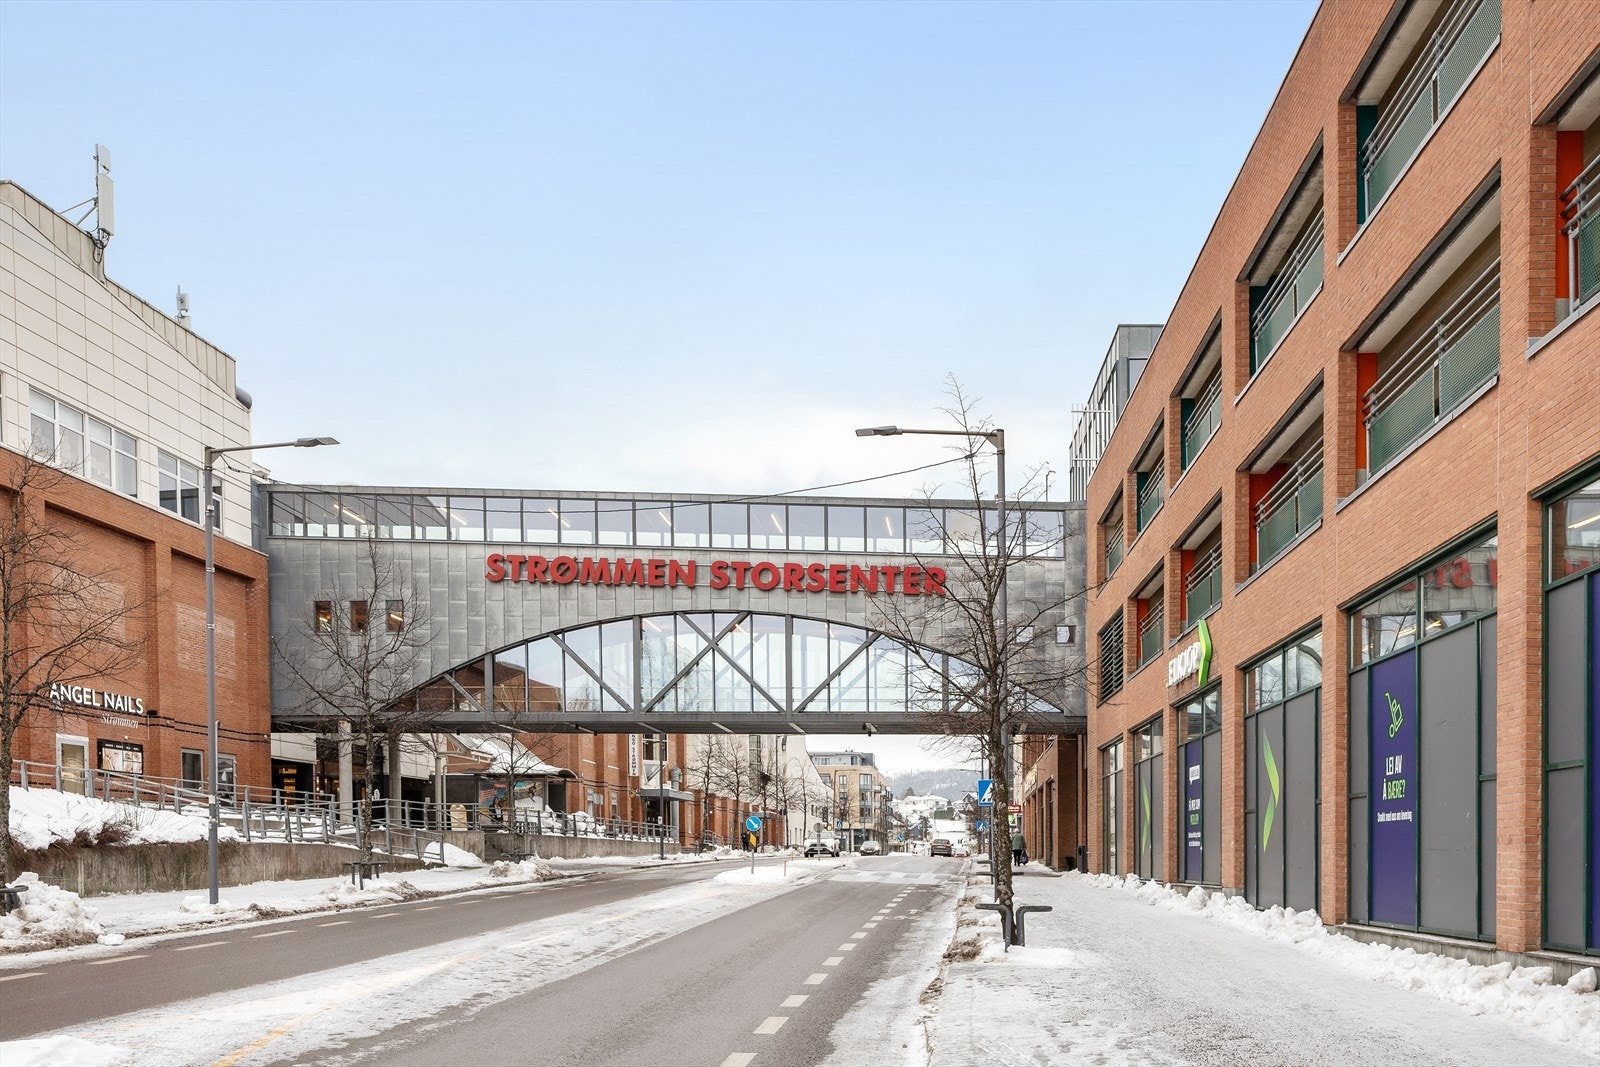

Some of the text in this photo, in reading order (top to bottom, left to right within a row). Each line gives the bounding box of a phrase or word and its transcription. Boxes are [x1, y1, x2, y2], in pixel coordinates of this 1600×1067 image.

[486, 553, 947, 595] STRØMMEN STORSENTER
[49, 682, 143, 714] ANGEL NAILS
[101, 714, 139, 728] Strømmen
